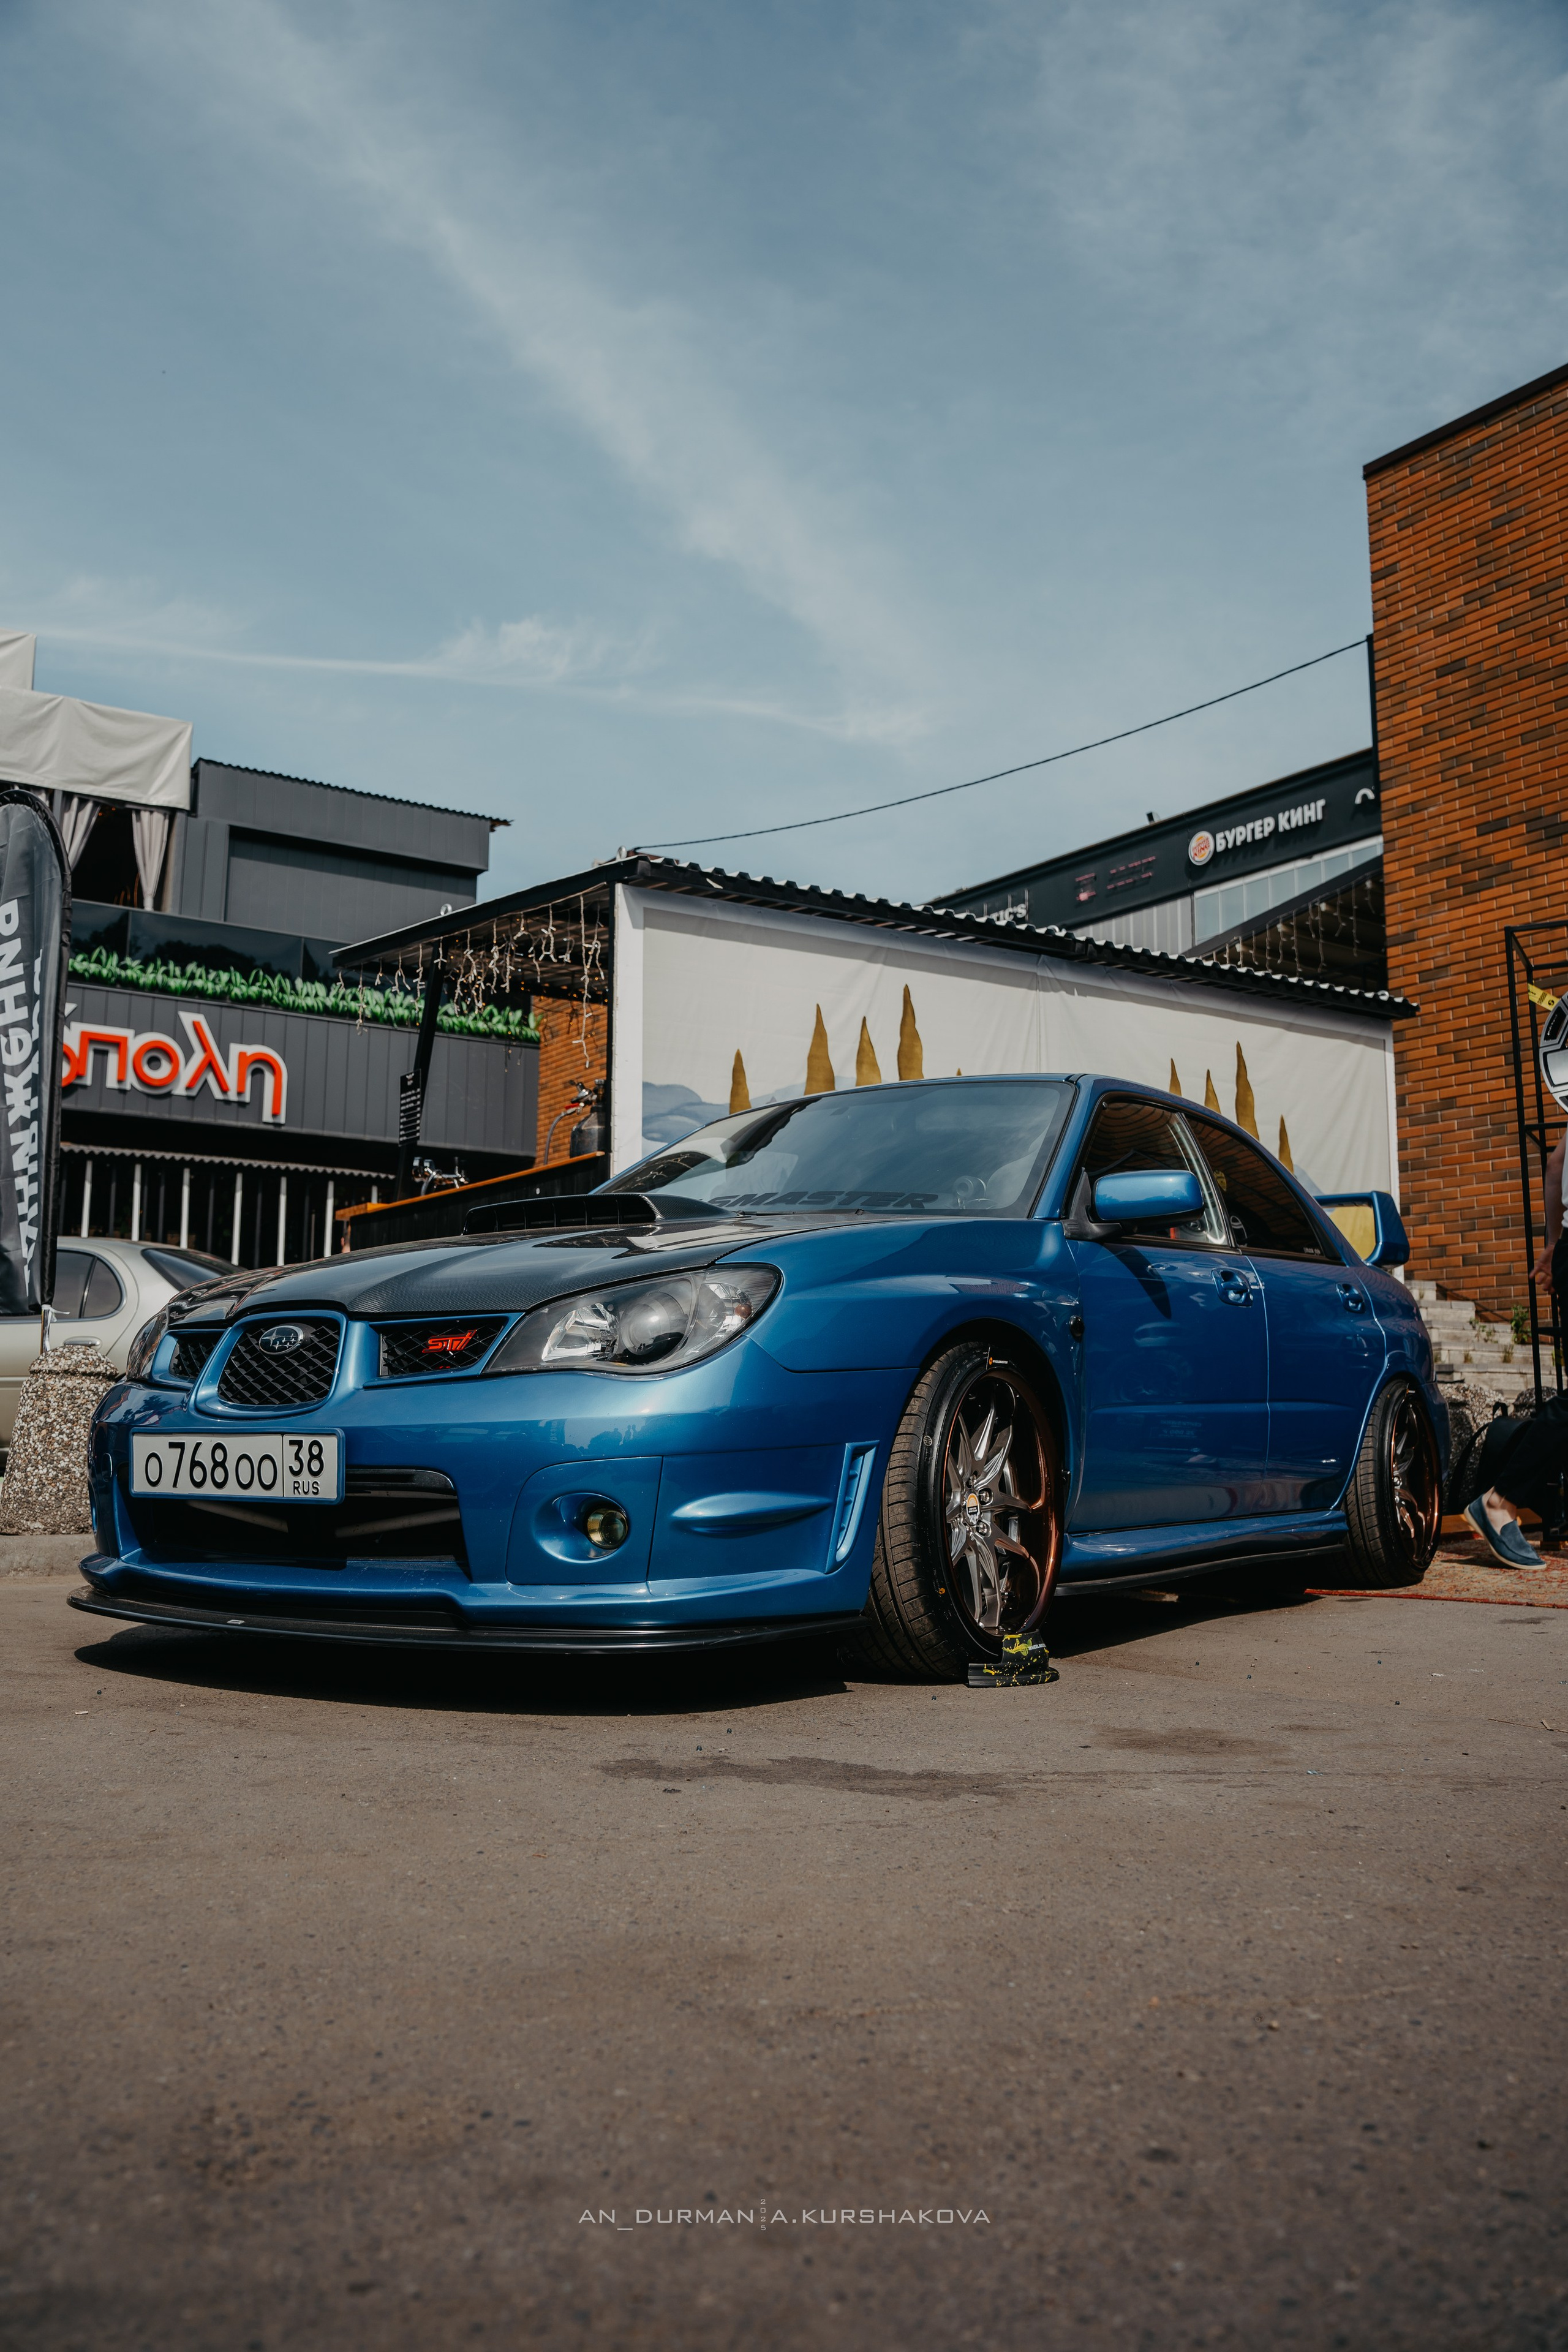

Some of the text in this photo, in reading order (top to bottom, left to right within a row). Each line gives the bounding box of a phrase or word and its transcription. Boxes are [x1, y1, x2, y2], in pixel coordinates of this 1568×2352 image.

[1216, 799, 1326, 852] БУРГЕР КИНГ
[704, 1191, 937, 1209] SMASTER
[288, 1439, 325, 1477] 38
[293, 1480, 320, 1495] RUS
